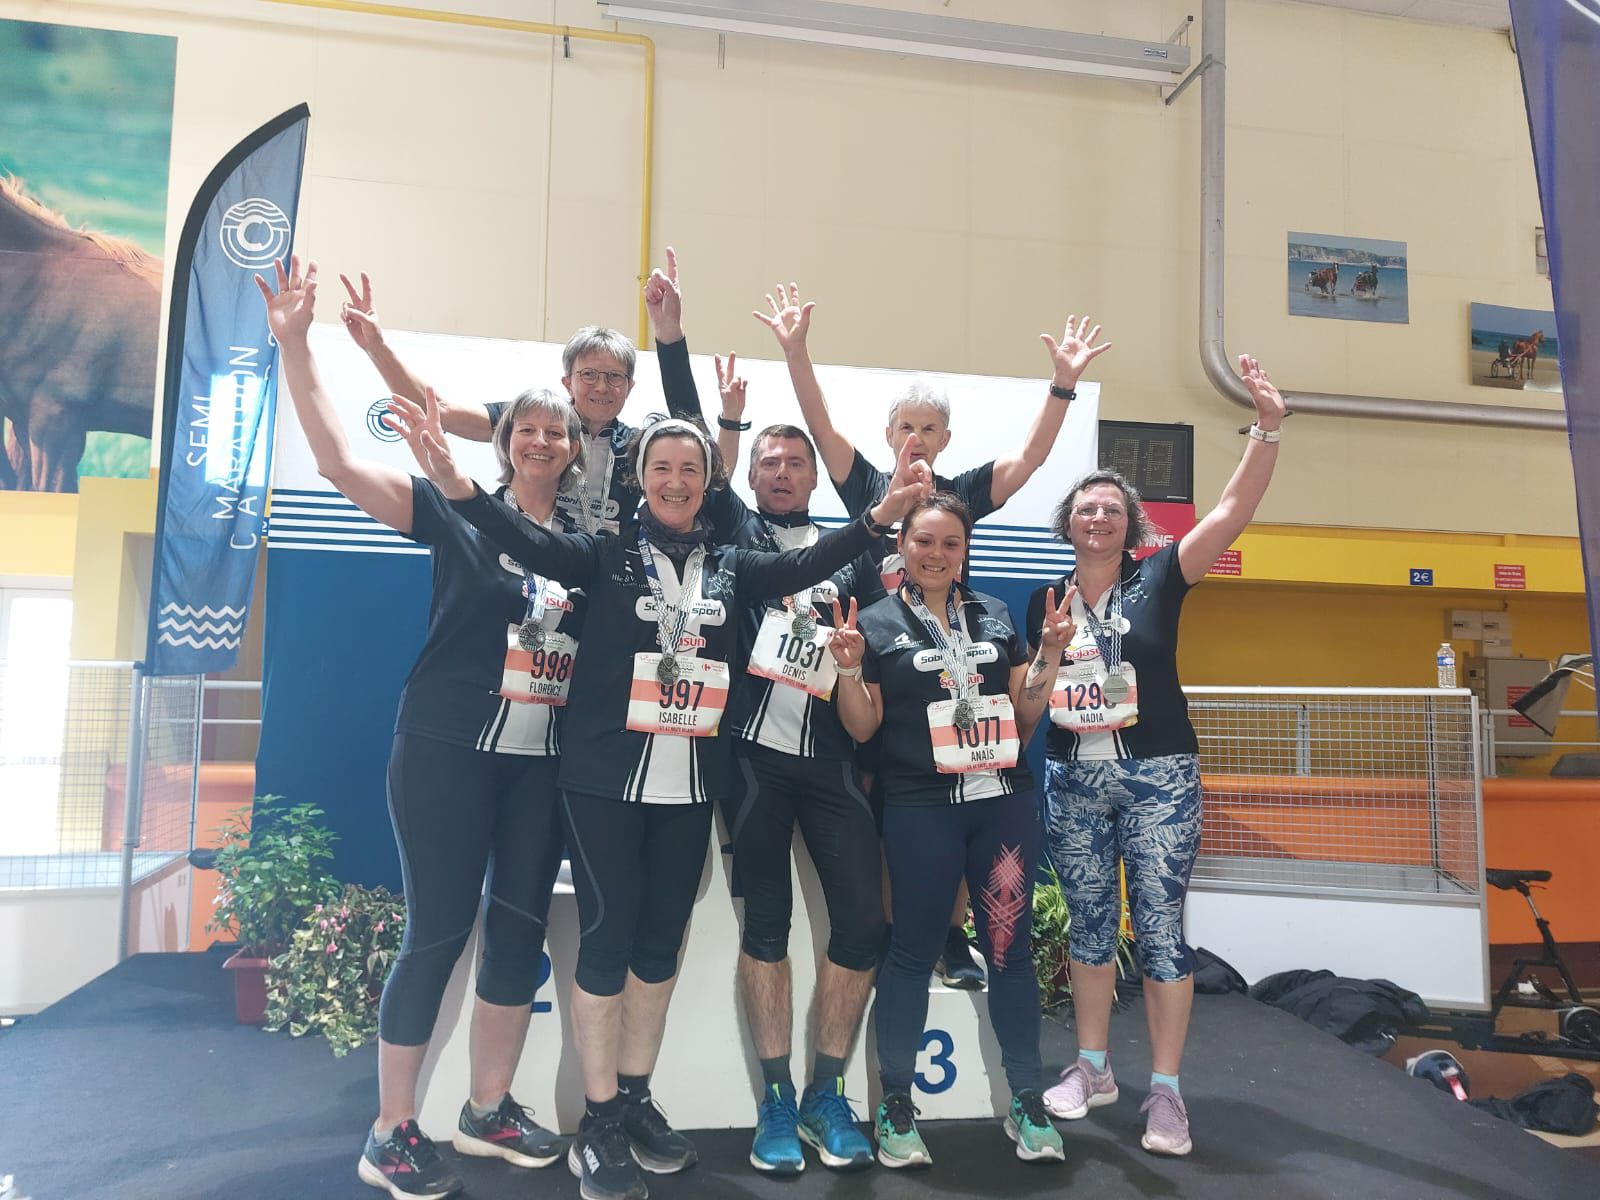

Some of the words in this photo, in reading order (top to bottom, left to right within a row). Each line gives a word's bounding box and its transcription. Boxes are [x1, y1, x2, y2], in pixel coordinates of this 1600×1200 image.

[186, 395, 212, 467] SEMI
[1413, 572, 1430, 583] 2€
[692, 607, 721, 616] sport
[777, 633, 825, 672] 1031
[966, 648, 993, 657] sport
[530, 650, 572, 683] 998
[782, 664, 807, 681] DENIS
[529, 681, 562, 697] FLORENCE
[659, 679, 704, 711] 997
[659, 711, 698, 727] ISABELLE
[1080, 713, 1104, 723] NADIA
[953, 716, 1000, 749] 1077
[971, 748, 995, 762] ANAÏS
[913, 1029, 957, 1094] 3
